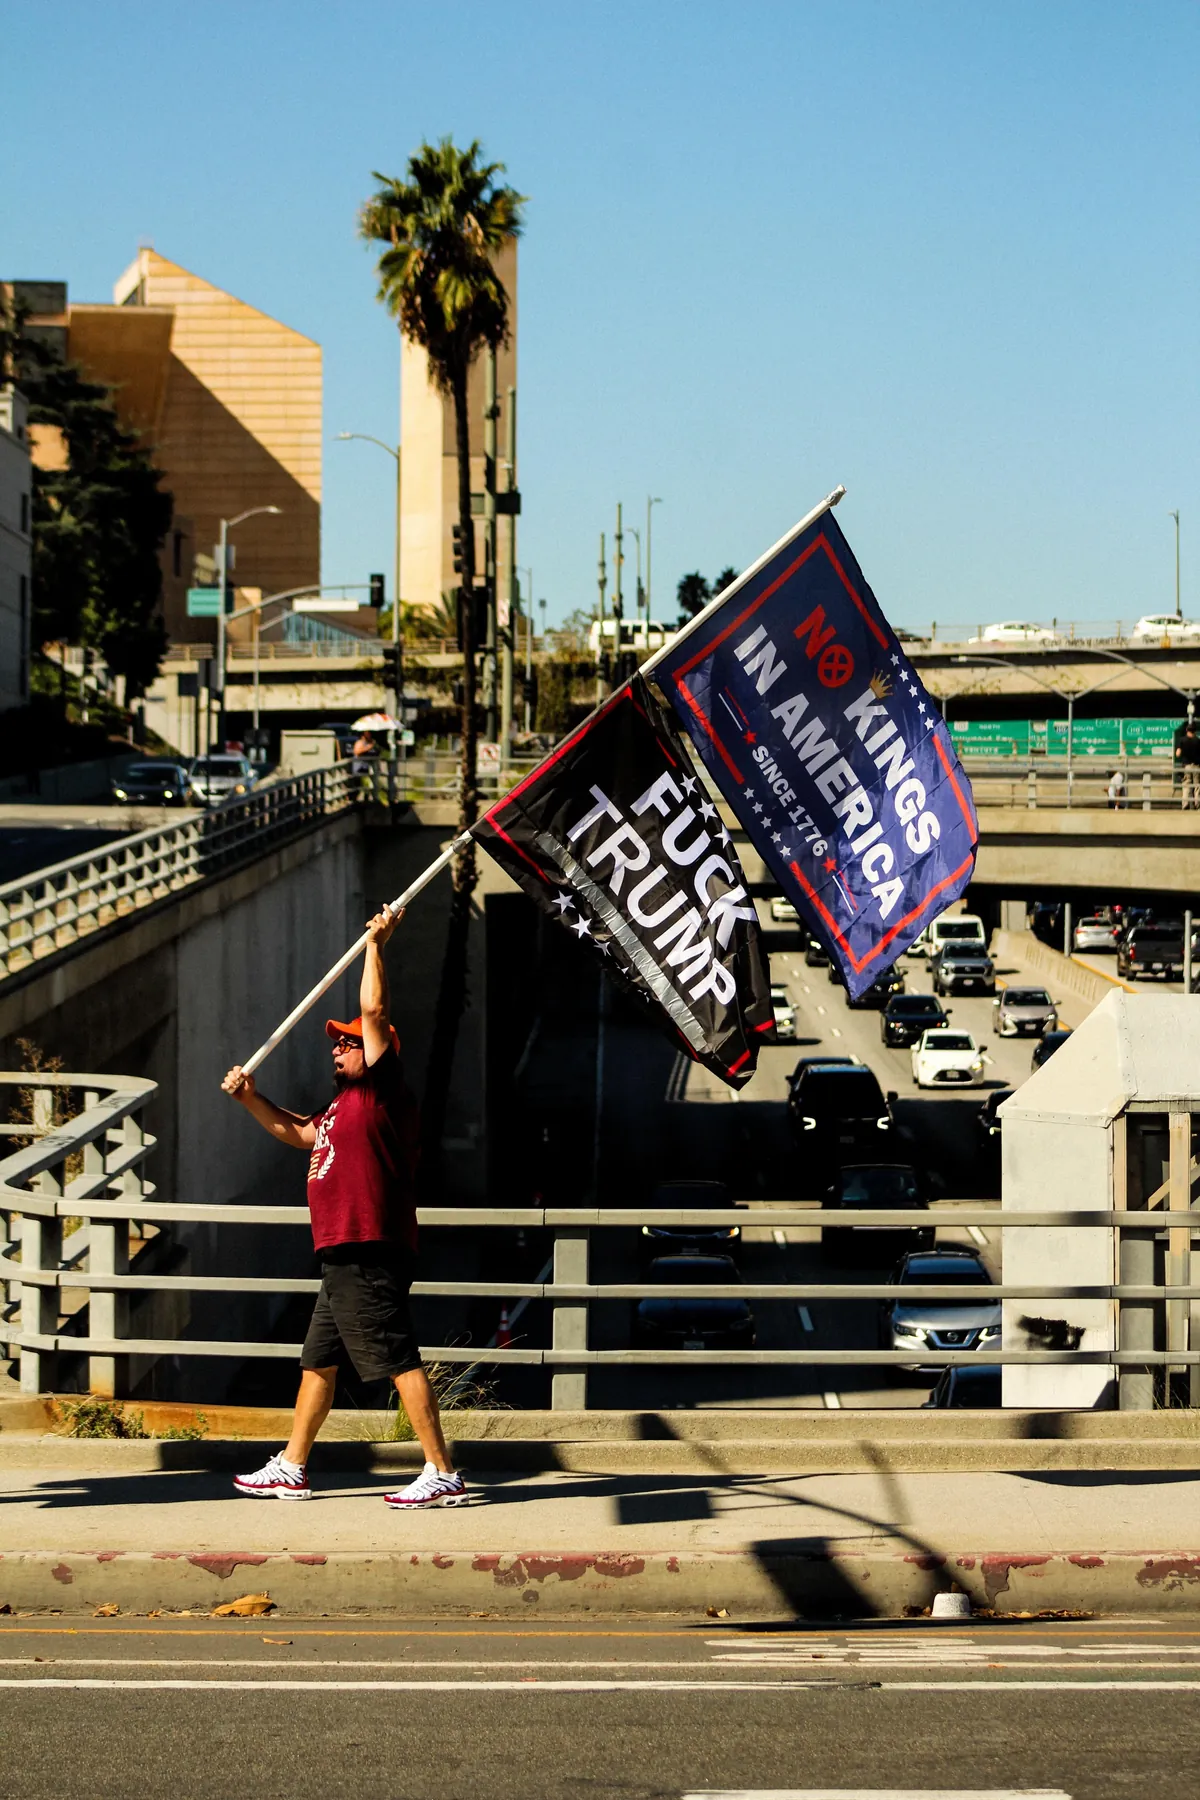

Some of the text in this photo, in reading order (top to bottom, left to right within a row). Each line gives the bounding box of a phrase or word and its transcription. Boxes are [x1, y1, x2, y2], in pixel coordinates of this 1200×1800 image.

[733, 624, 904, 920] IN AMERICA
[752, 745, 828, 856] SINCE 1776
[793, 604, 941, 854] NO KINGS
[1061, 736, 1078, 744] Sn
[566, 784, 736, 1005] TRUMP
[630, 770, 758, 951] FUCK
